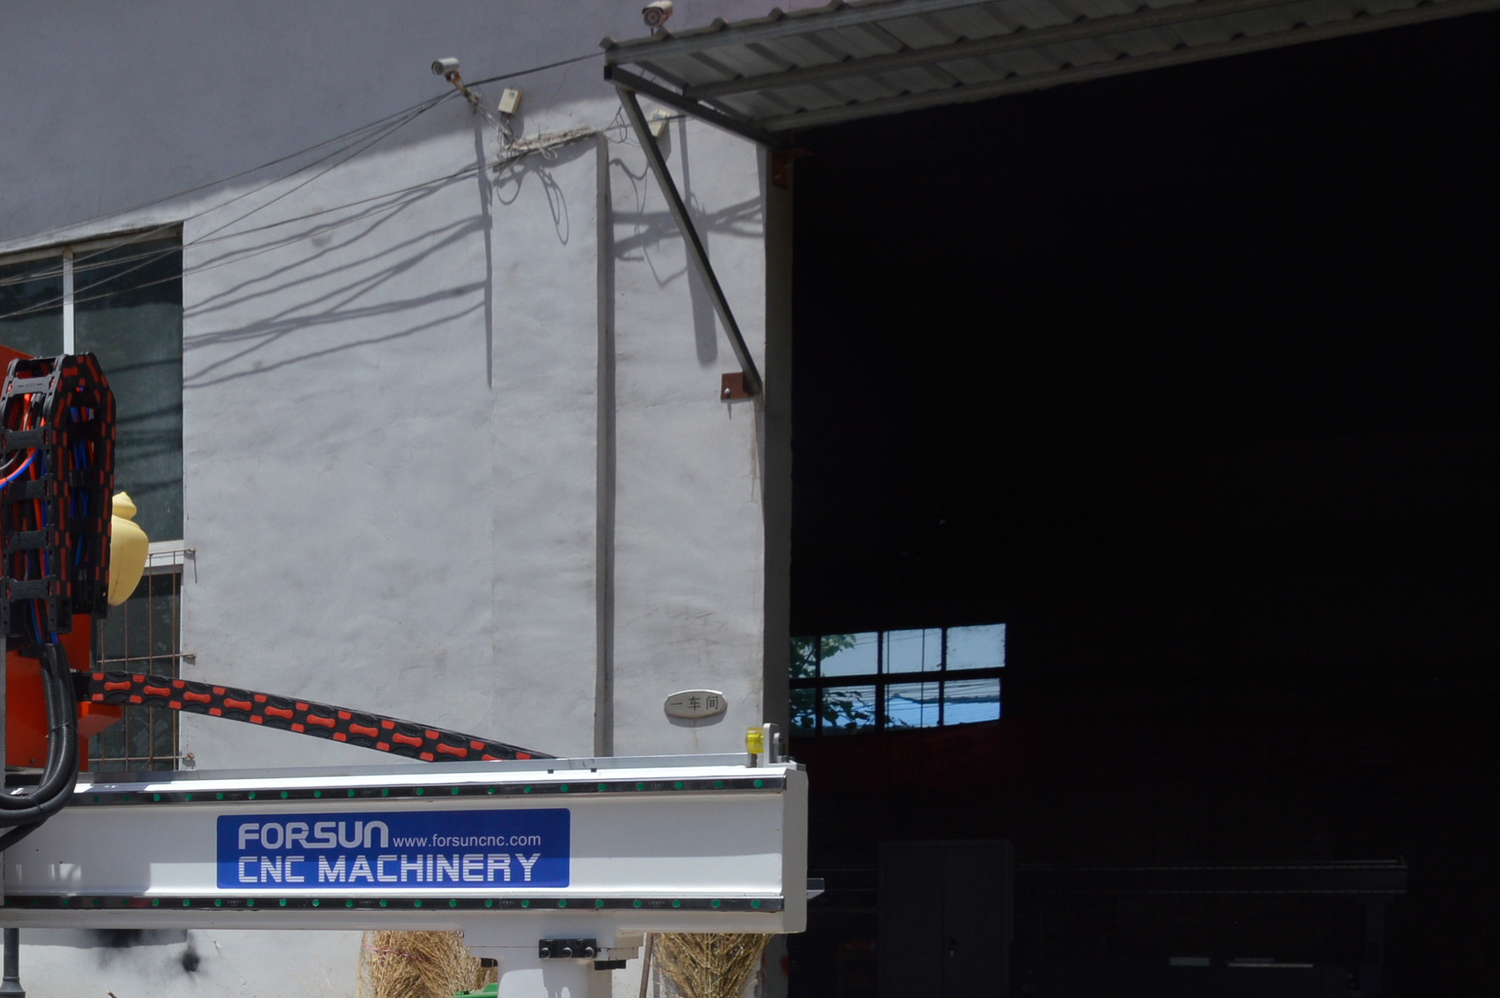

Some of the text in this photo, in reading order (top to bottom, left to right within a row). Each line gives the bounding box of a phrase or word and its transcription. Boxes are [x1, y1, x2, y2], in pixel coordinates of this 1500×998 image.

[669, 696, 719, 711] 一车间
[238, 820, 541, 850] FORSUN www.forsuncnc.com
[238, 853, 541, 883] CNC MACHINERY
